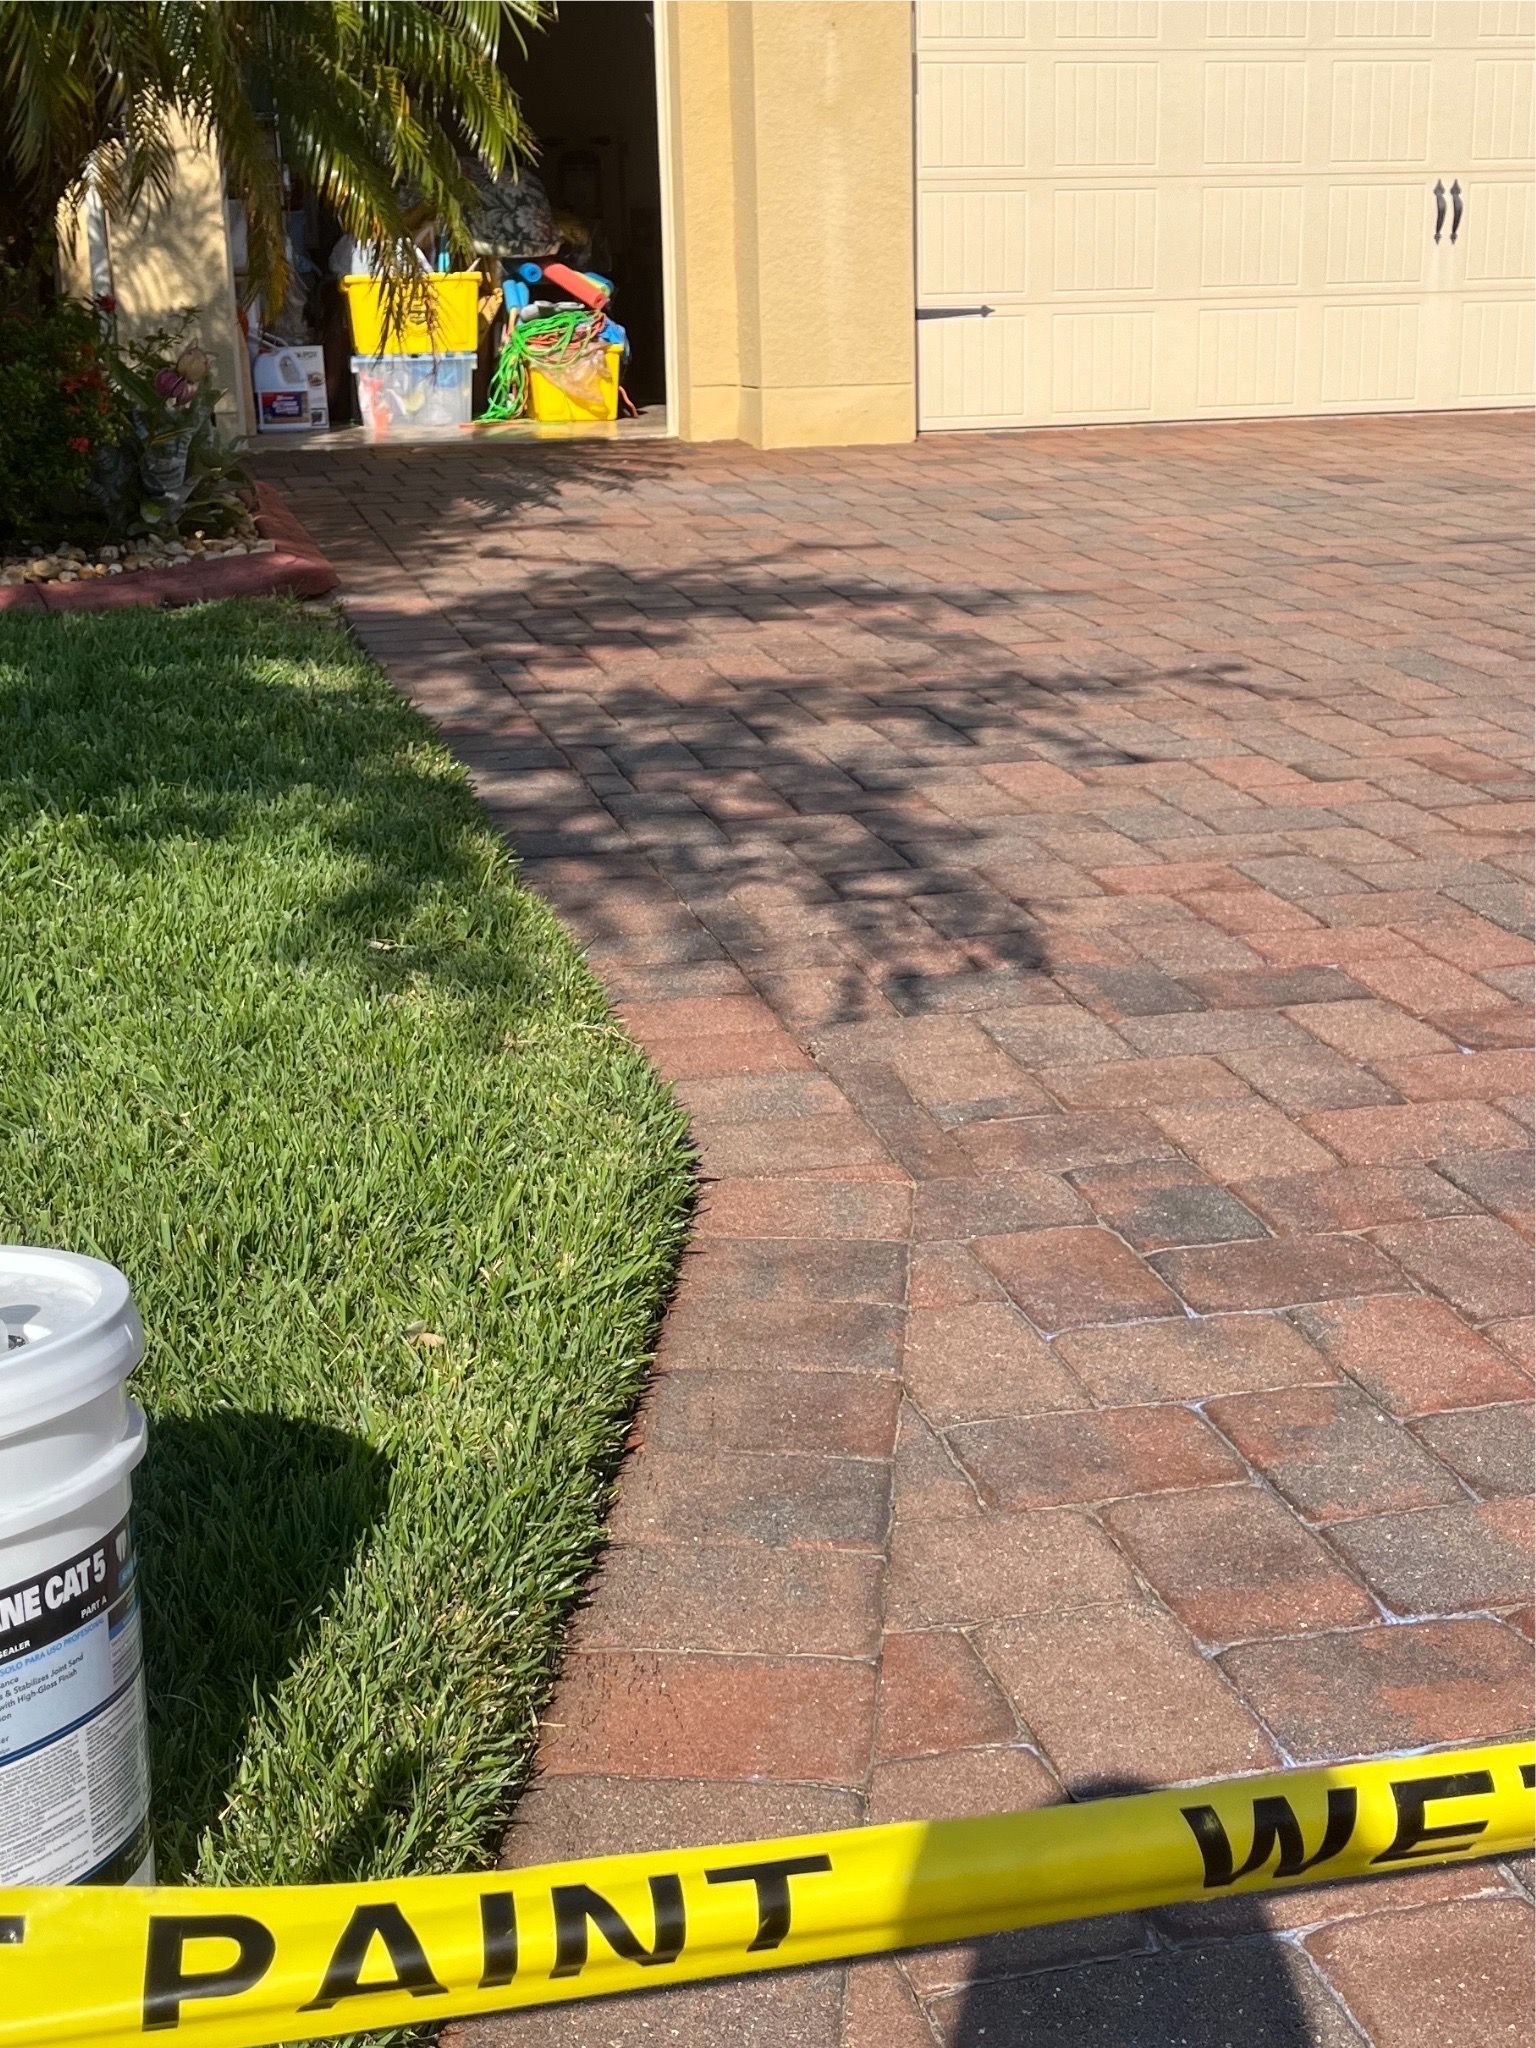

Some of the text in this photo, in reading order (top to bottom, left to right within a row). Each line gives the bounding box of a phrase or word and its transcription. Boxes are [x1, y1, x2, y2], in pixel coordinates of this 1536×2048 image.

[0, 1548, 107, 1631] NE CAT 5
[81, 1595, 107, 1619] PART A
[25, 1651, 46, 1667] PARA
[47, 1642, 63, 1656] USO
[5, 1690, 12, 1698] &
[13, 1673, 50, 1695] Stabilizes
[51, 1662, 68, 1678] Joint
[68, 1652, 84, 1668] Sand
[17, 1680, 58, 1702] High-Gloss
[58, 1669, 78, 1684] Finish
[141, 1763, 1536, 2032] PAINT WE
